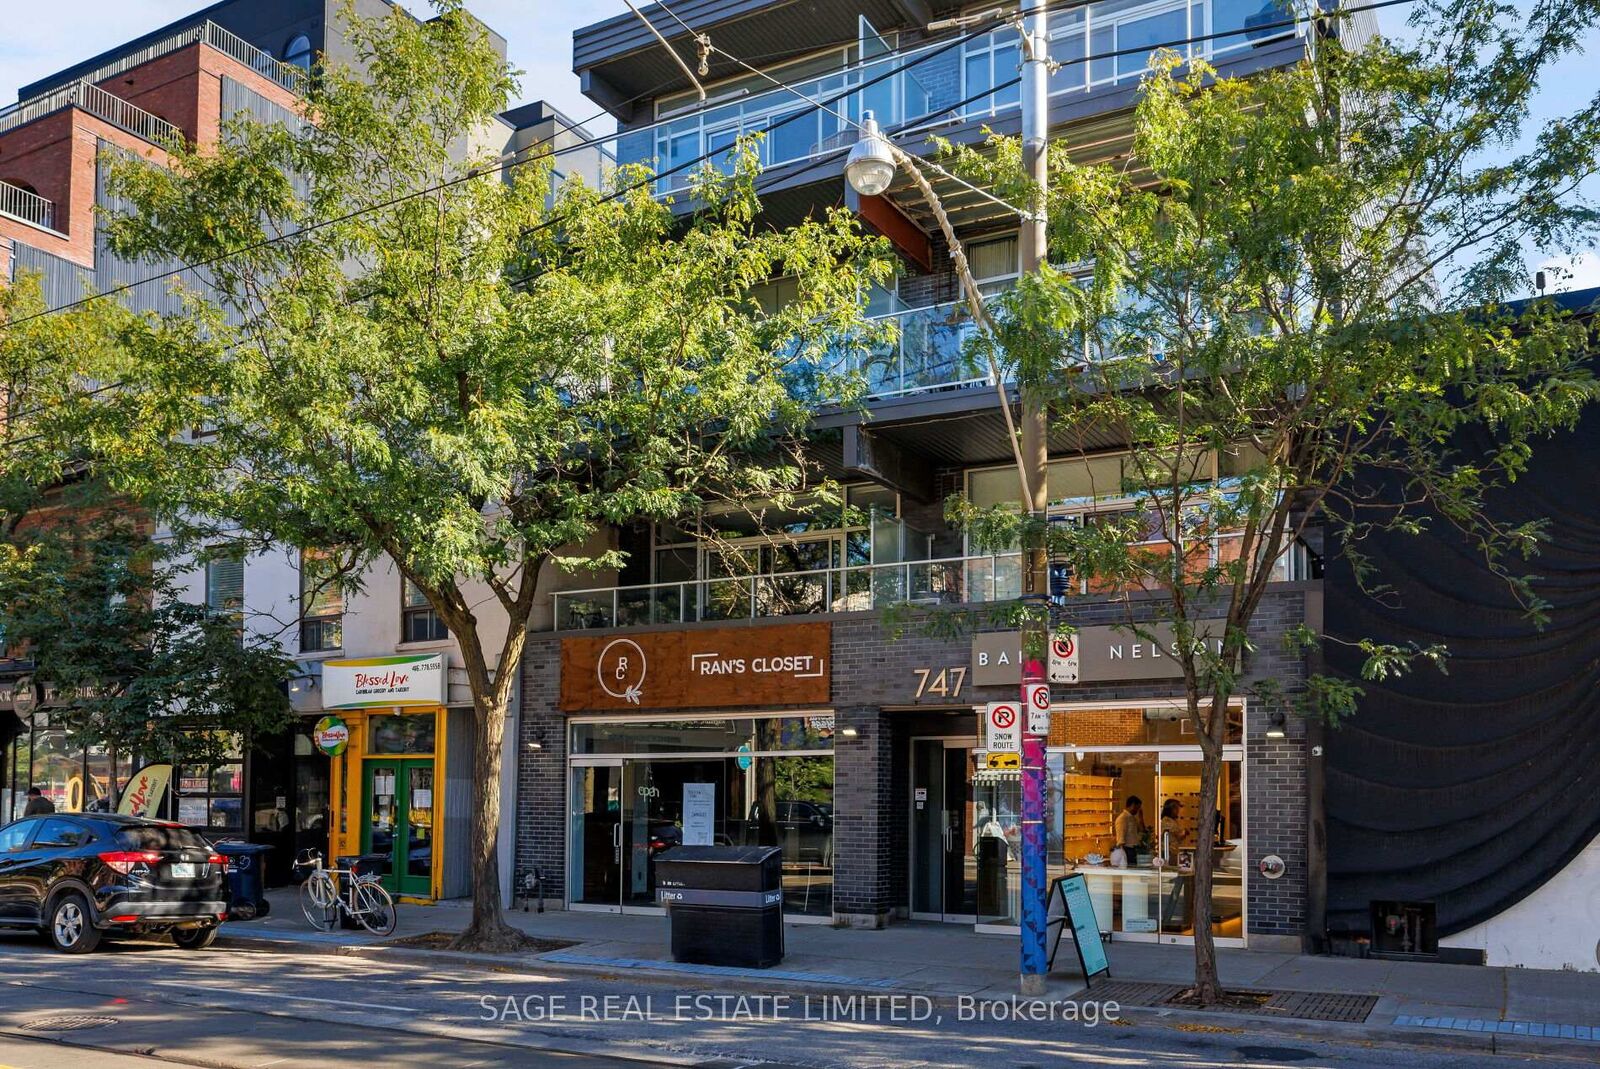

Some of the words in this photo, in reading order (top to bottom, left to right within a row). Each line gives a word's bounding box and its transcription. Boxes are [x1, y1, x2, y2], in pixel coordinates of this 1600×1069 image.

[618, 656, 628, 669] R
[700, 658, 746, 675] RAN'S
[751, 655, 813, 673] CLOSET
[355, 671, 389, 688] Blessed
[390, 670, 409, 688] Love
[615, 666, 625, 680] C
[914, 666, 967, 698] 747
[993, 741, 1014, 749] ROUTE
[660, 890, 676, 902] Litter
